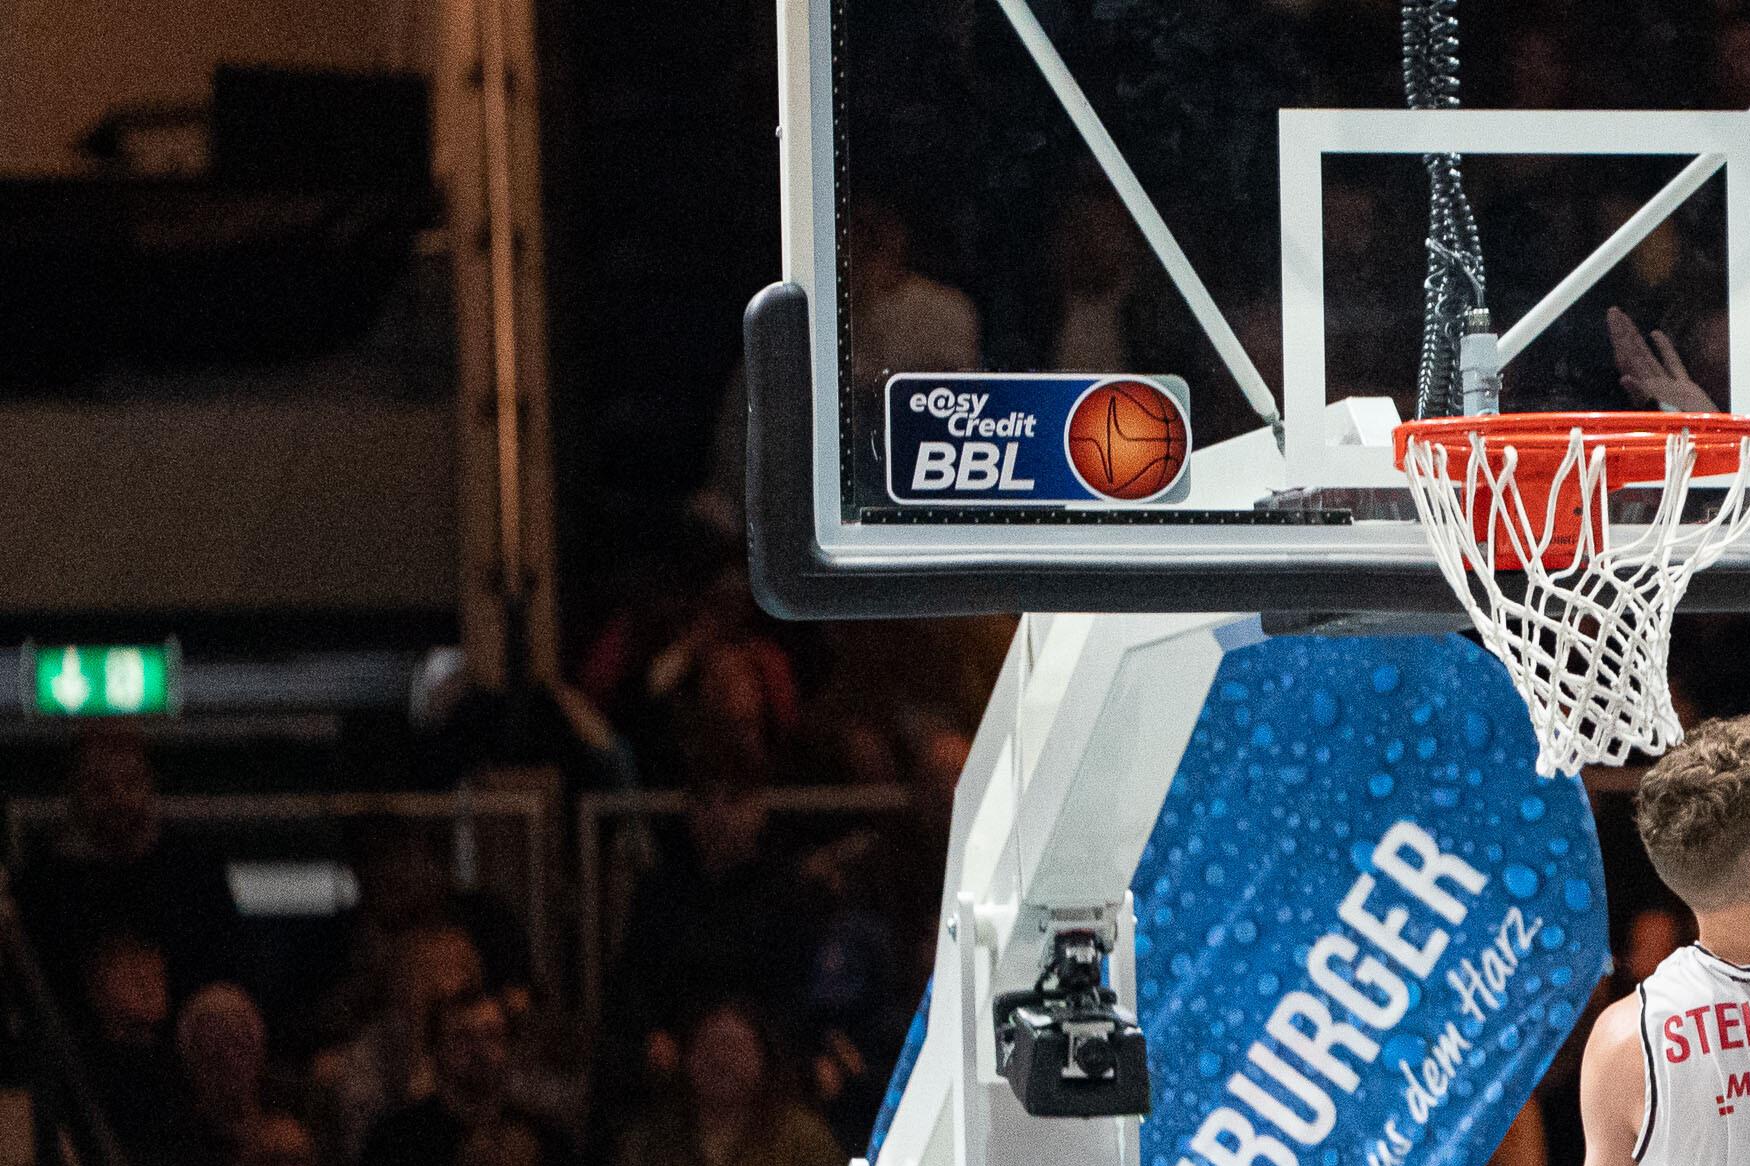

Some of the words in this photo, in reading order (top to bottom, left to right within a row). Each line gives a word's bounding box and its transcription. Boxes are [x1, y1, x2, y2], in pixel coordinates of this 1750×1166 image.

[947, 412, 1037, 438] Credit
[911, 440, 1036, 491] BBL
[1406, 1023, 1473, 1121] dem
[1448, 906, 1544, 1020] Harz
